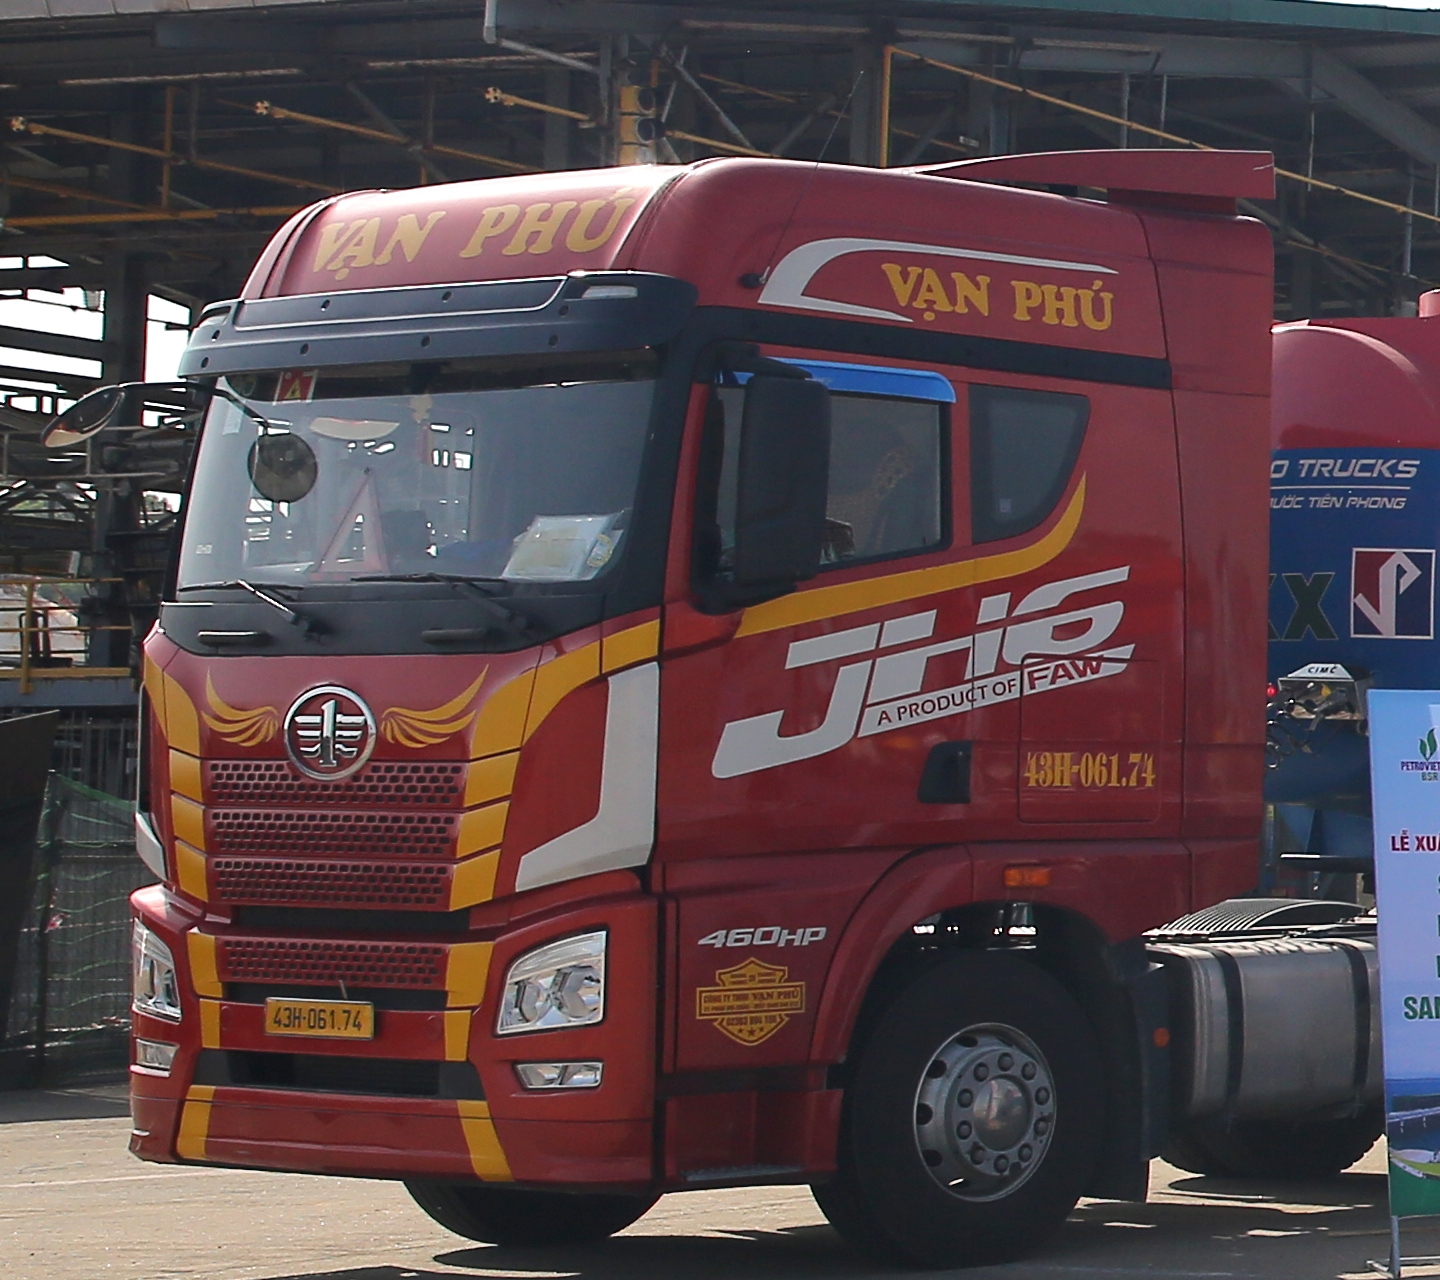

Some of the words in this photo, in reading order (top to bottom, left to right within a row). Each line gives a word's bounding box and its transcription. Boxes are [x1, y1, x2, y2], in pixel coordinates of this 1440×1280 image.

[312, 210, 446, 280] VẠN
[459, 187, 636, 259] PHÚ
[881, 262, 991, 321] VẠN
[1011, 278, 1114, 331] PHÚ
[1298, 459, 1421, 479] TRUCKS
[1308, 494, 1344, 508] TIÊN
[1346, 497, 1407, 509] PHONG
[877, 710, 892, 727] A
[896, 683, 987, 721] PRODUCT
[992, 678, 1017, 697] OF
[1027, 655, 1104, 691] FAW
[1023, 751, 1156, 788] 43H-061.74
[1422, 772, 1438, 781] BSR
[1390, 829, 1411, 852] LỄ
[697, 926, 827, 948] 460HP
